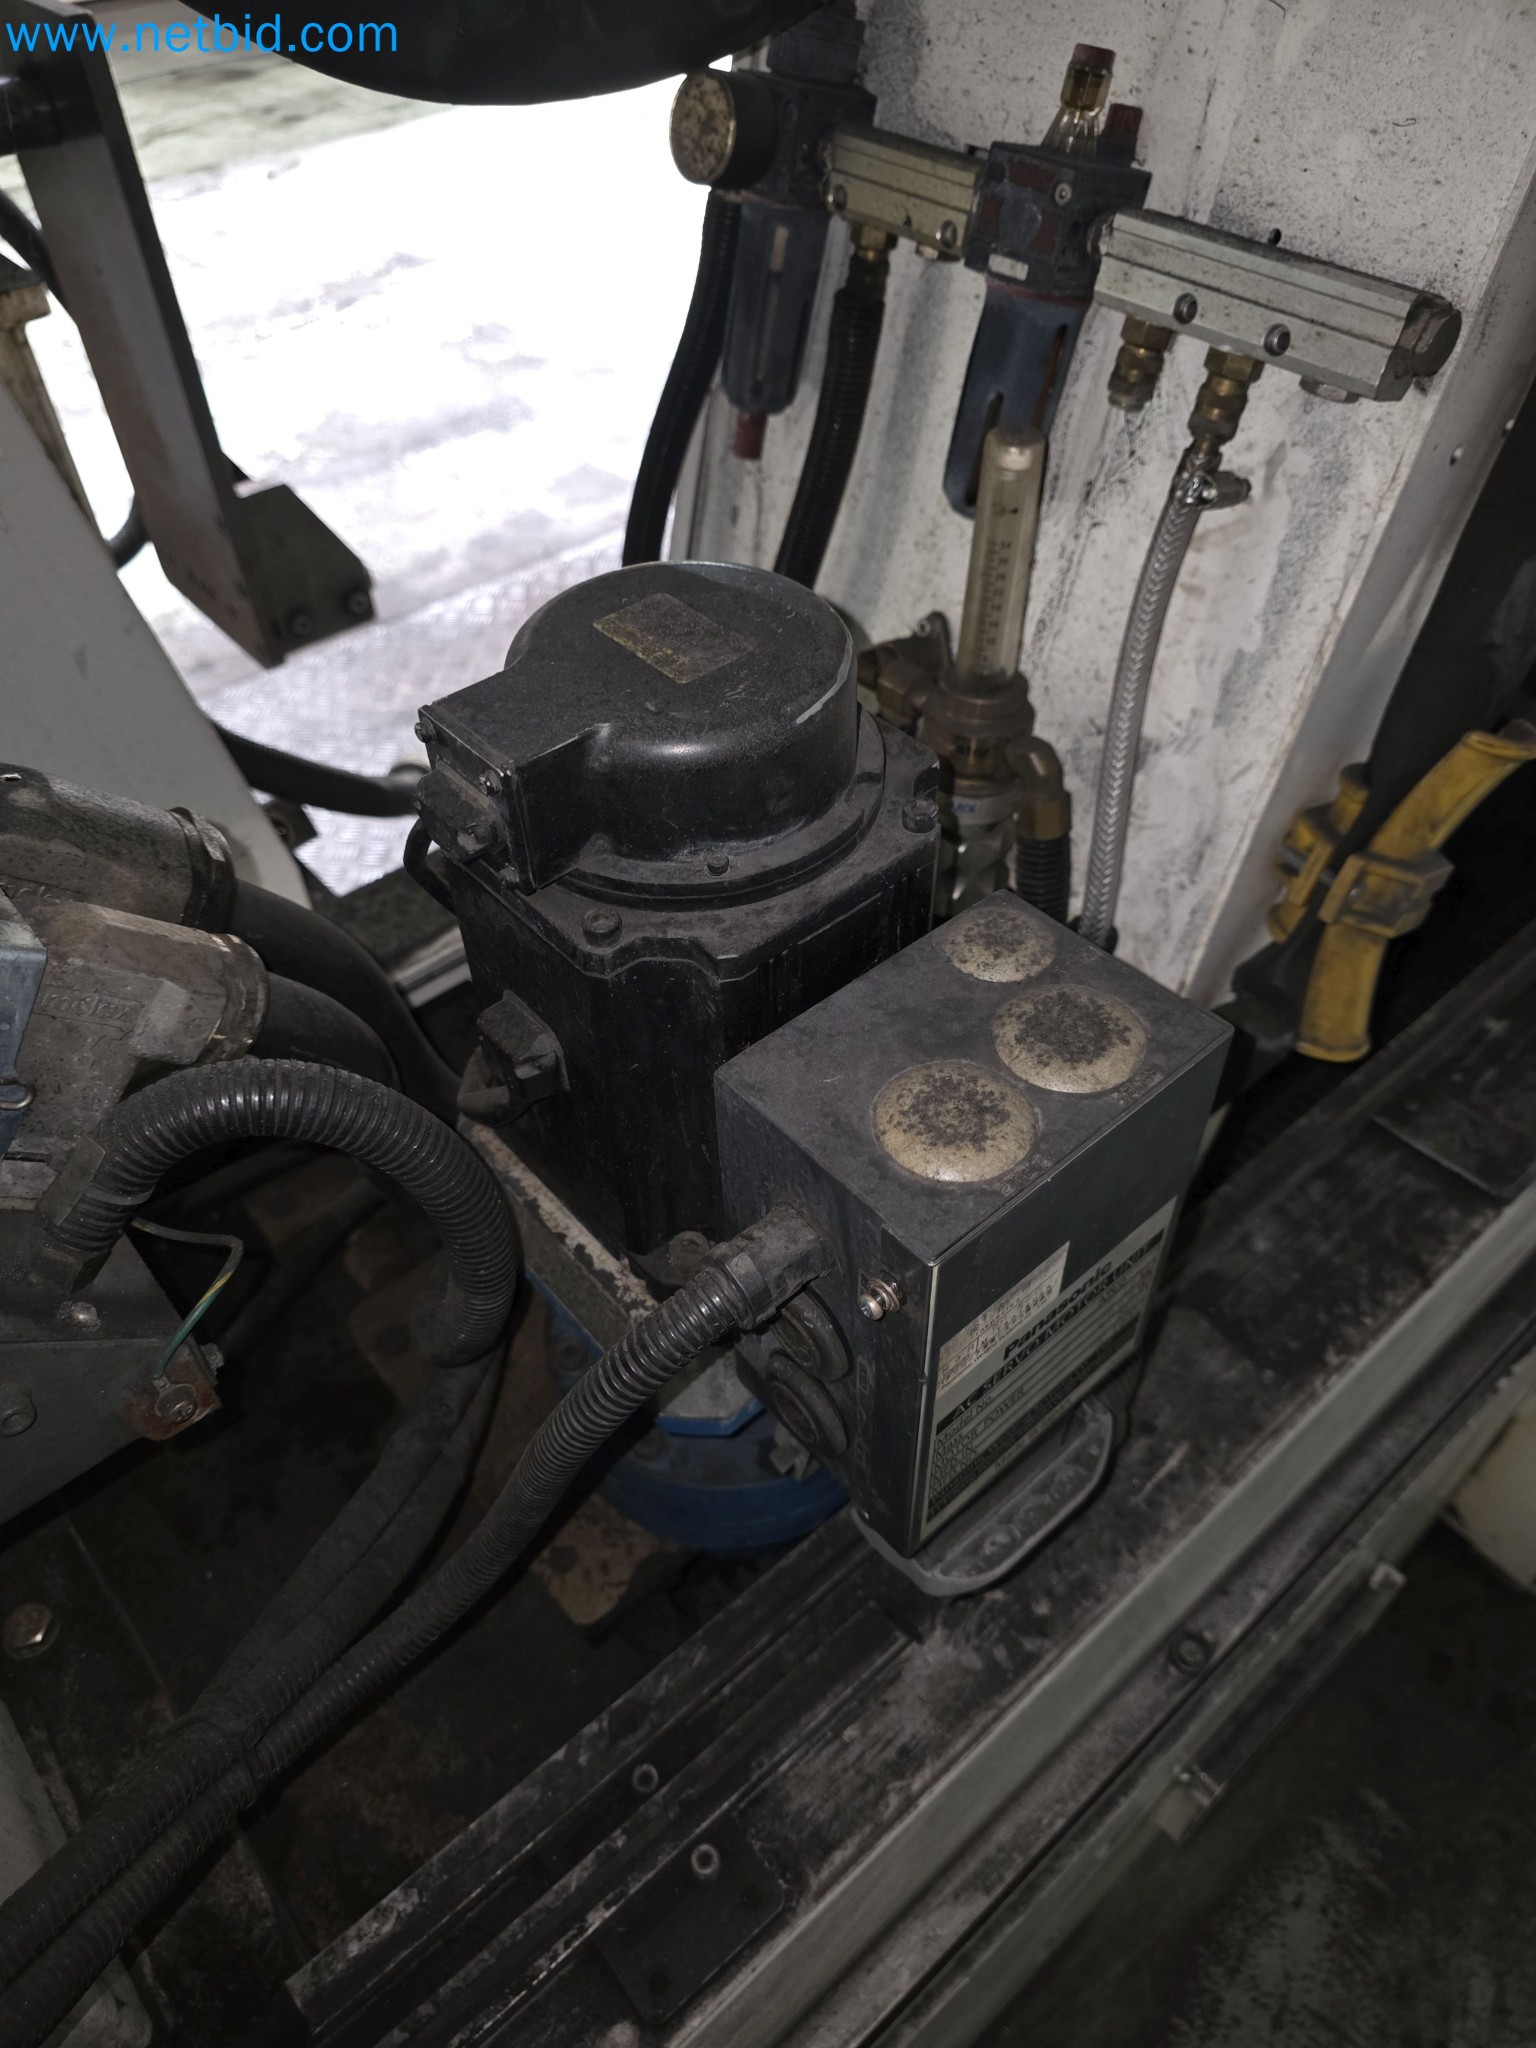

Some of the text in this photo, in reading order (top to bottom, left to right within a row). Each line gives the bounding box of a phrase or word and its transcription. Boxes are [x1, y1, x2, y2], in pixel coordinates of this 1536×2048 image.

[952, 1394, 977, 1420] AC
[982, 1337, 1041, 1393] SERVO
[1044, 1277, 1111, 1342] MOTOR
[1112, 1244, 1147, 1281] UNIT
[1002, 1260, 1113, 1360] Panasonic
[936, 1410, 973, 1448] Model
